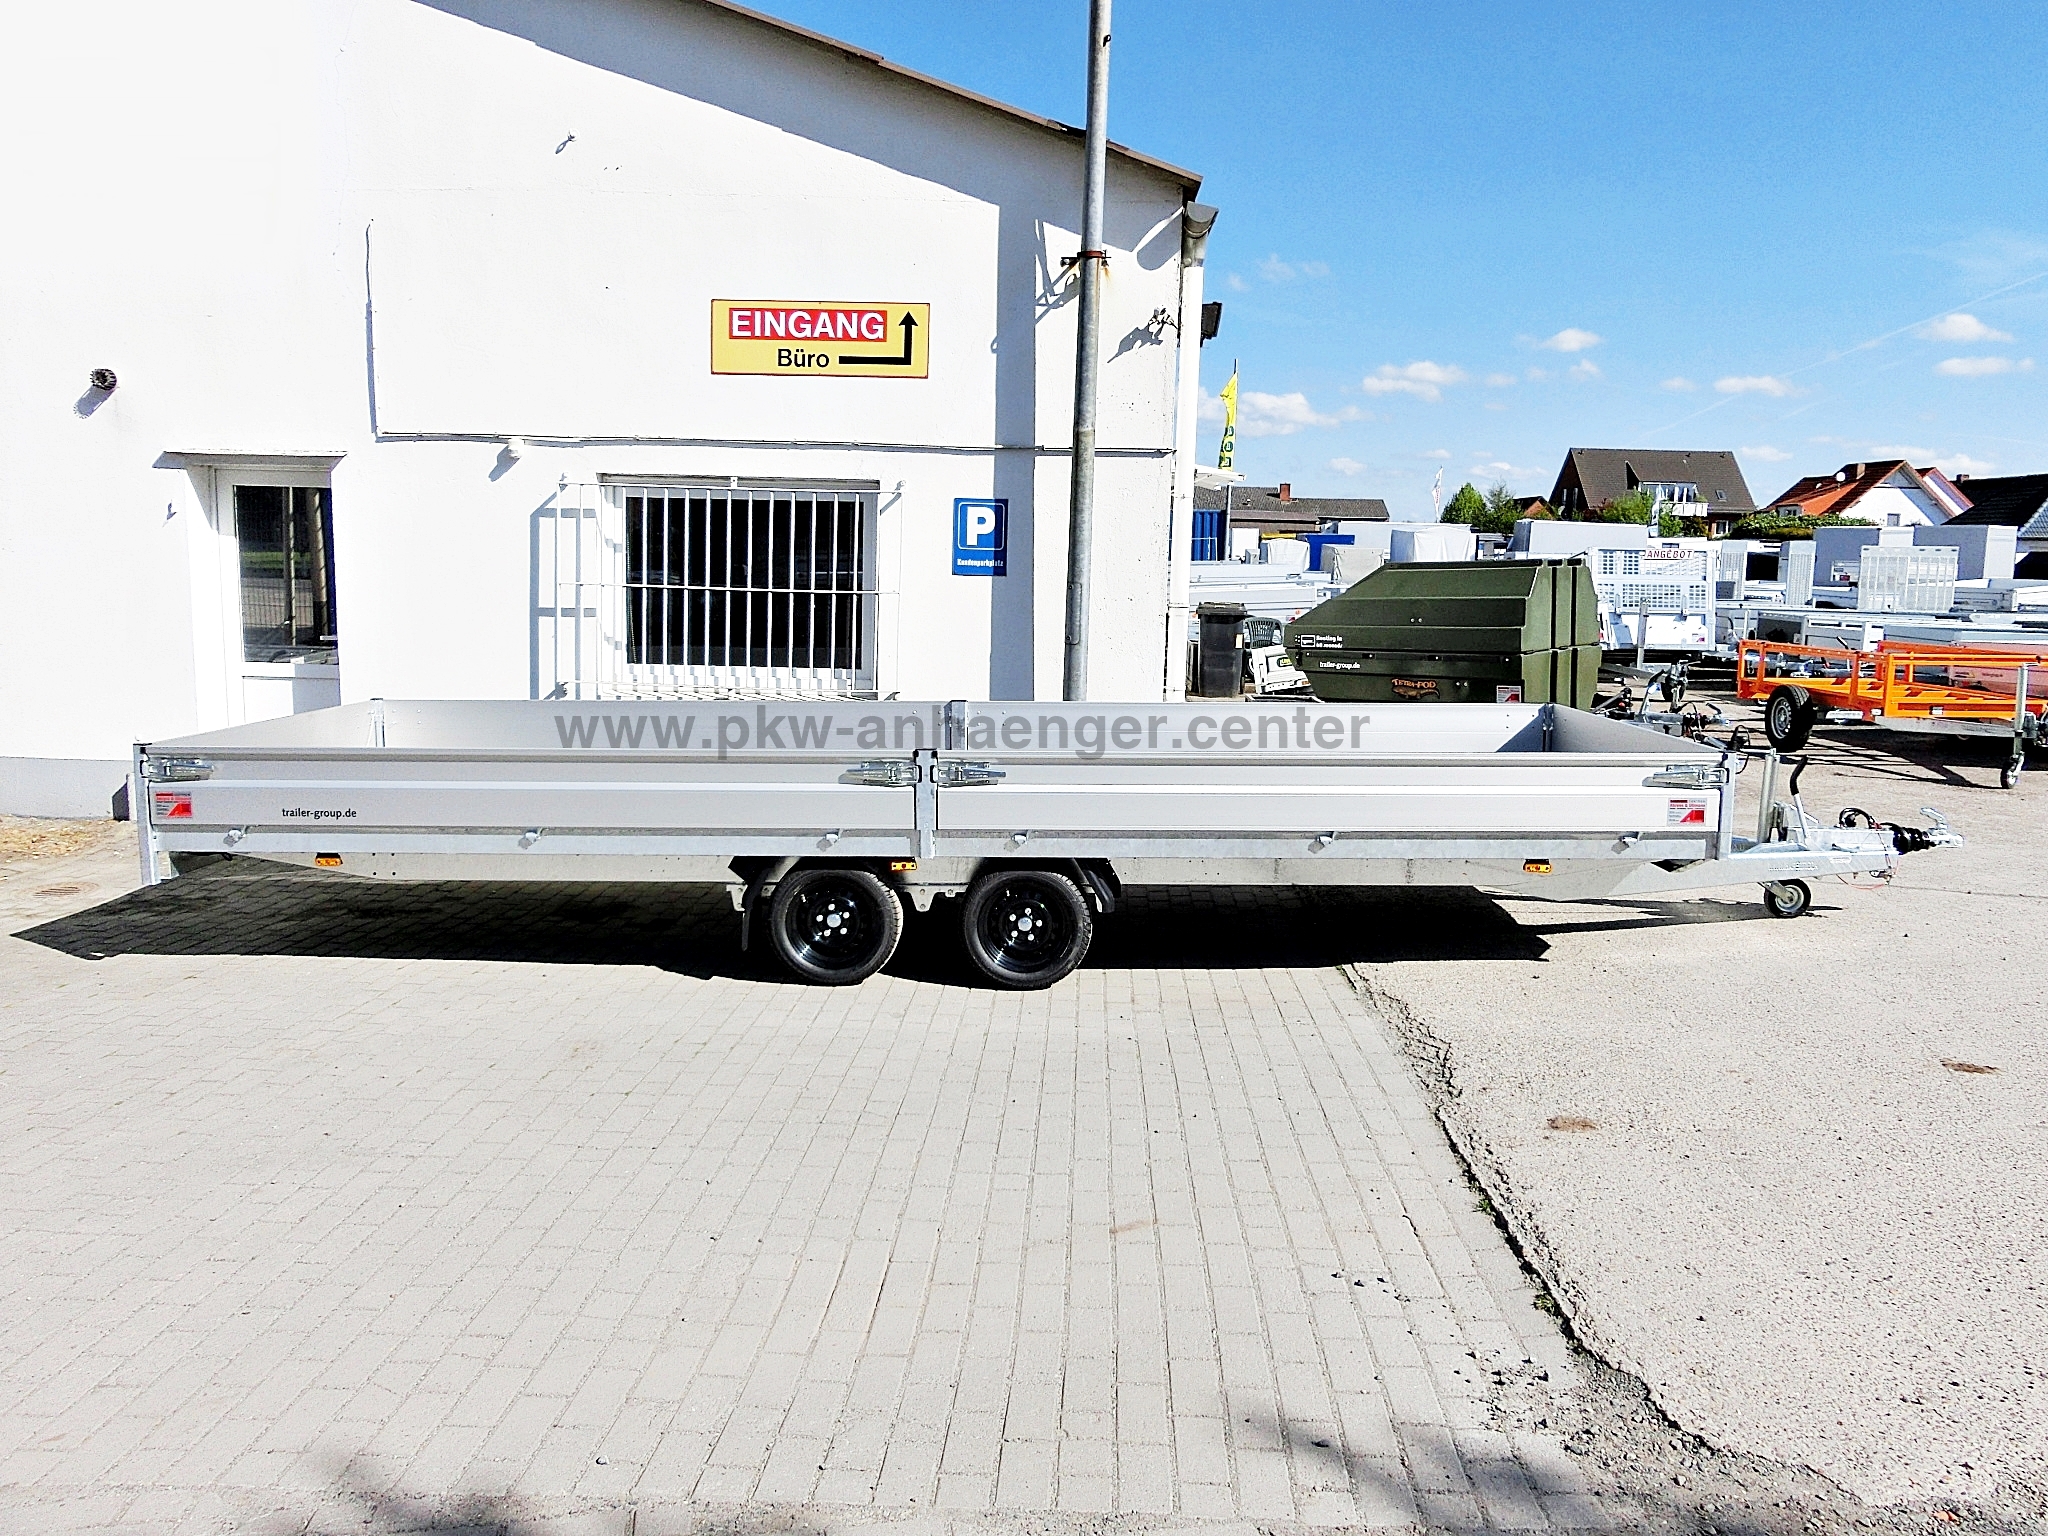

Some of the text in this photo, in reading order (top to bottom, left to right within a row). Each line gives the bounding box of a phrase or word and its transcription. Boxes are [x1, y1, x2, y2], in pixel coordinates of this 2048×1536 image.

[731, 310, 884, 340] EINGANG
[777, 348, 830, 368] Büro
[966, 506, 996, 546] P
[1646, 550, 1693, 559] ANGEBOT
[1319, 661, 1360, 669] trailer-group.de
[282, 808, 357, 820] trailer-group.de
